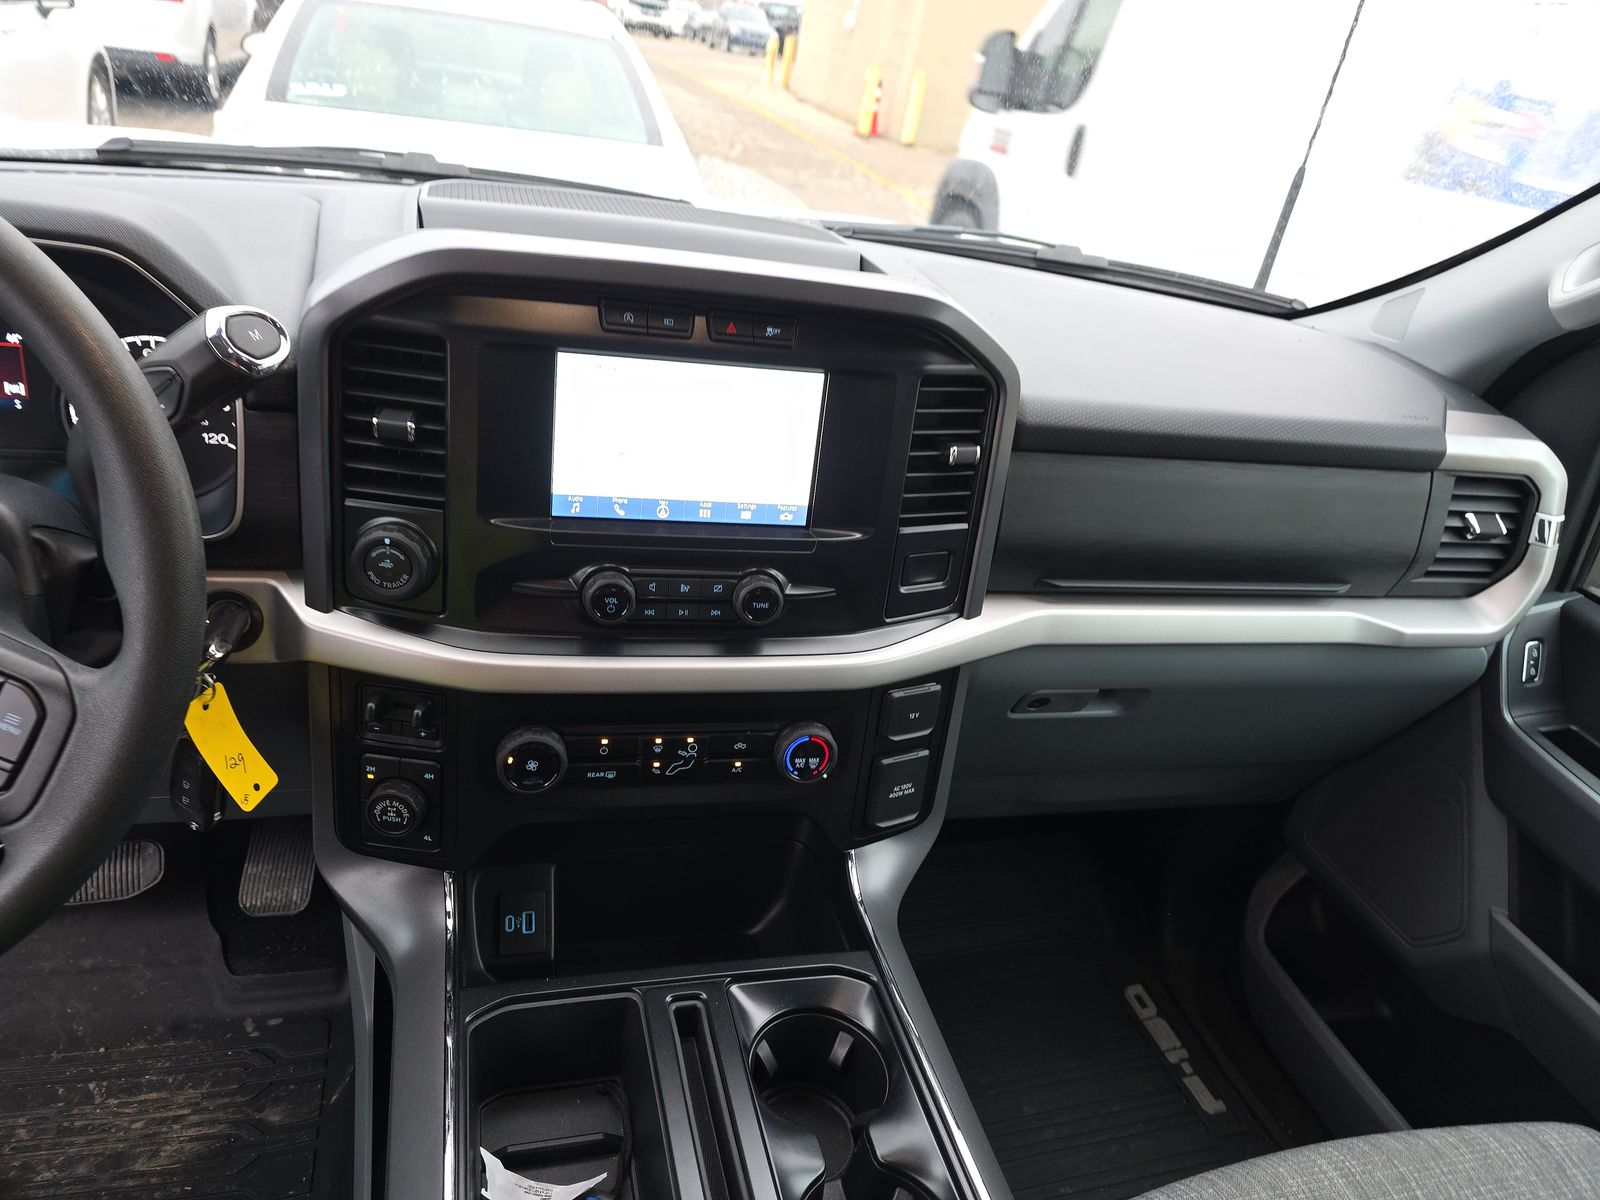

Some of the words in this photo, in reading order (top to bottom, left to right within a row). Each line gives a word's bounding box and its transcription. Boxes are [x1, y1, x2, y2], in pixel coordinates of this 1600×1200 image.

[247, 328, 263, 342] M
[201, 432, 229, 445] 120
[567, 495, 584, 503] Audio
[612, 497, 629, 505] Phone
[699, 501, 713, 509] Apps
[737, 502, 757, 511] Settings
[777, 504, 798, 512] Features
[367, 570, 381, 585] PRO
[382, 574, 410, 590] TRAILER
[224, 752, 247, 774] 129
[365, 765, 376, 773] 2H
[587, 771, 605, 779] REAR
[888, 790, 904, 799] 400W
[903, 787, 916, 795] MAX
[374, 799, 392, 816] DRIVE
[391, 800, 410, 818] MODE
[382, 815, 402, 823] PUSH
[1123, 982, 1227, 1116] F-150
